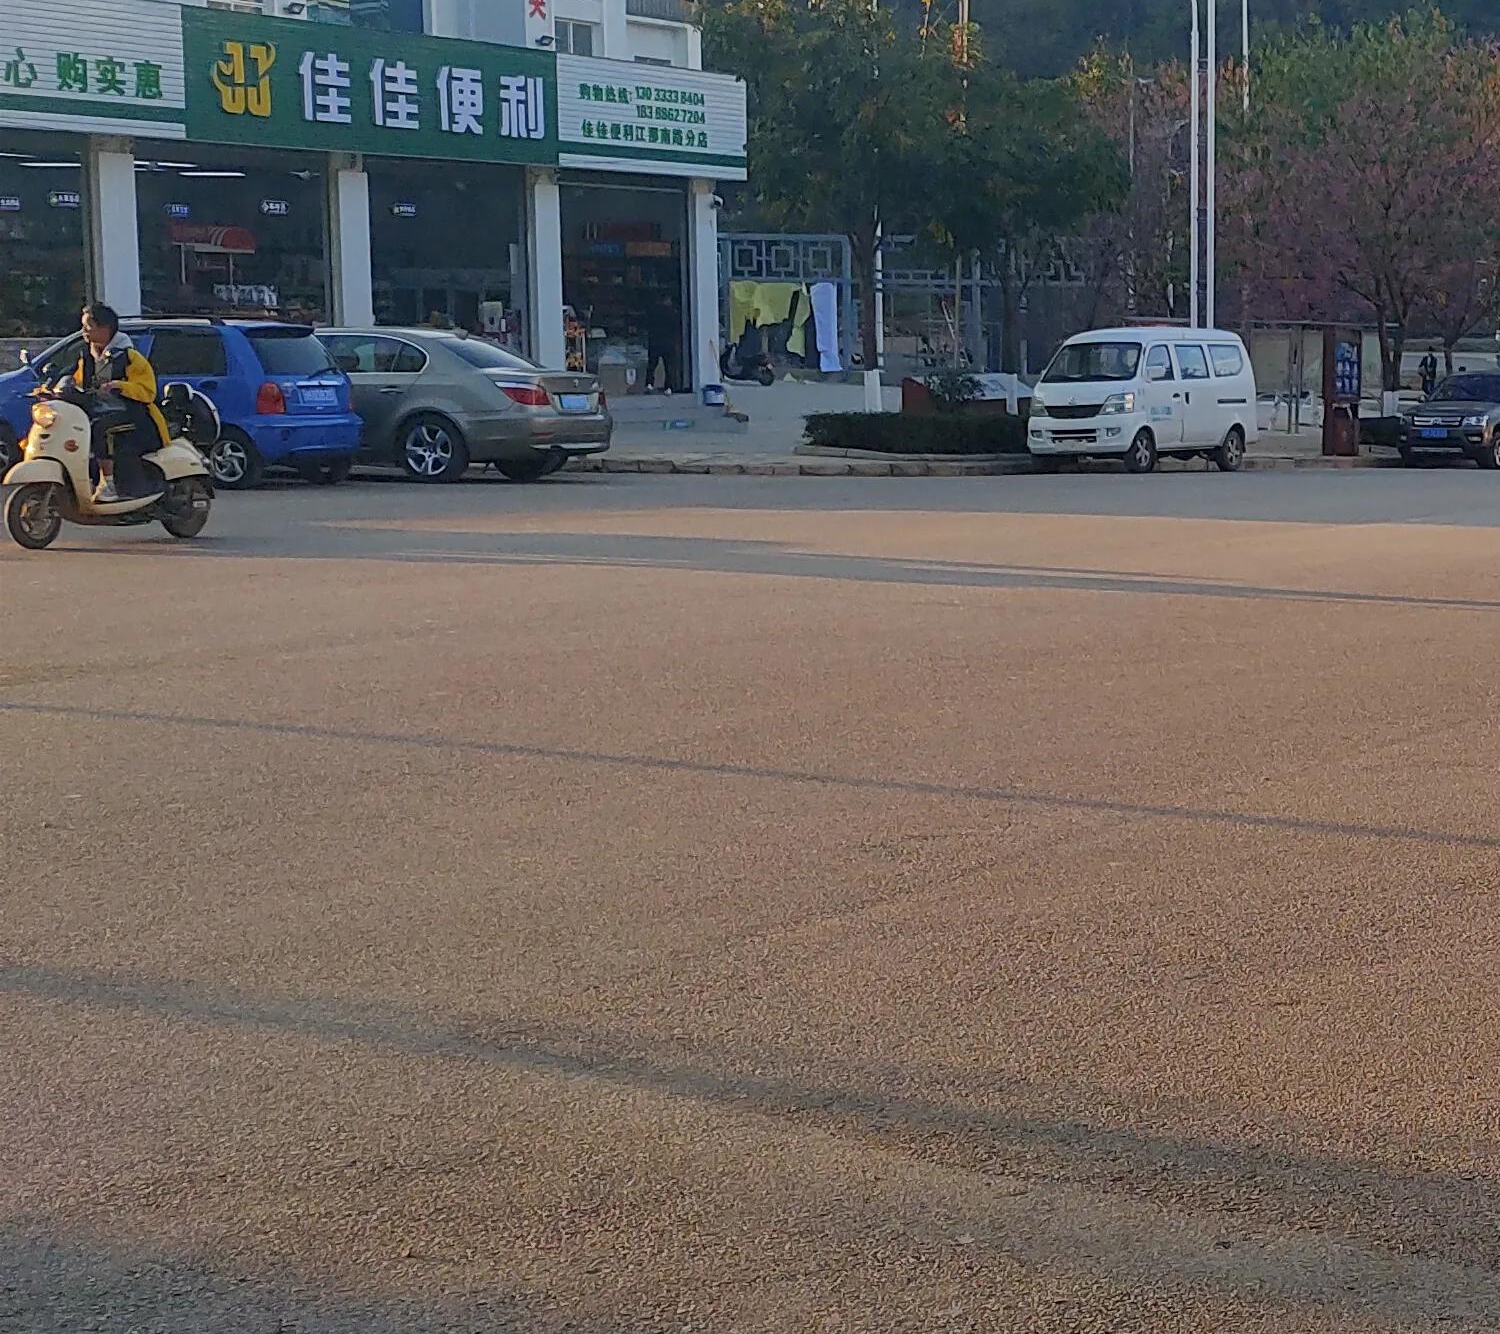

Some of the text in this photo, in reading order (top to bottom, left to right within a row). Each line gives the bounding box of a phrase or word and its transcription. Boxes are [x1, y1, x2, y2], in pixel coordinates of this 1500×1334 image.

[56, 52, 163, 99] 购实惠
[299, 51, 546, 140] 佳佳便利
